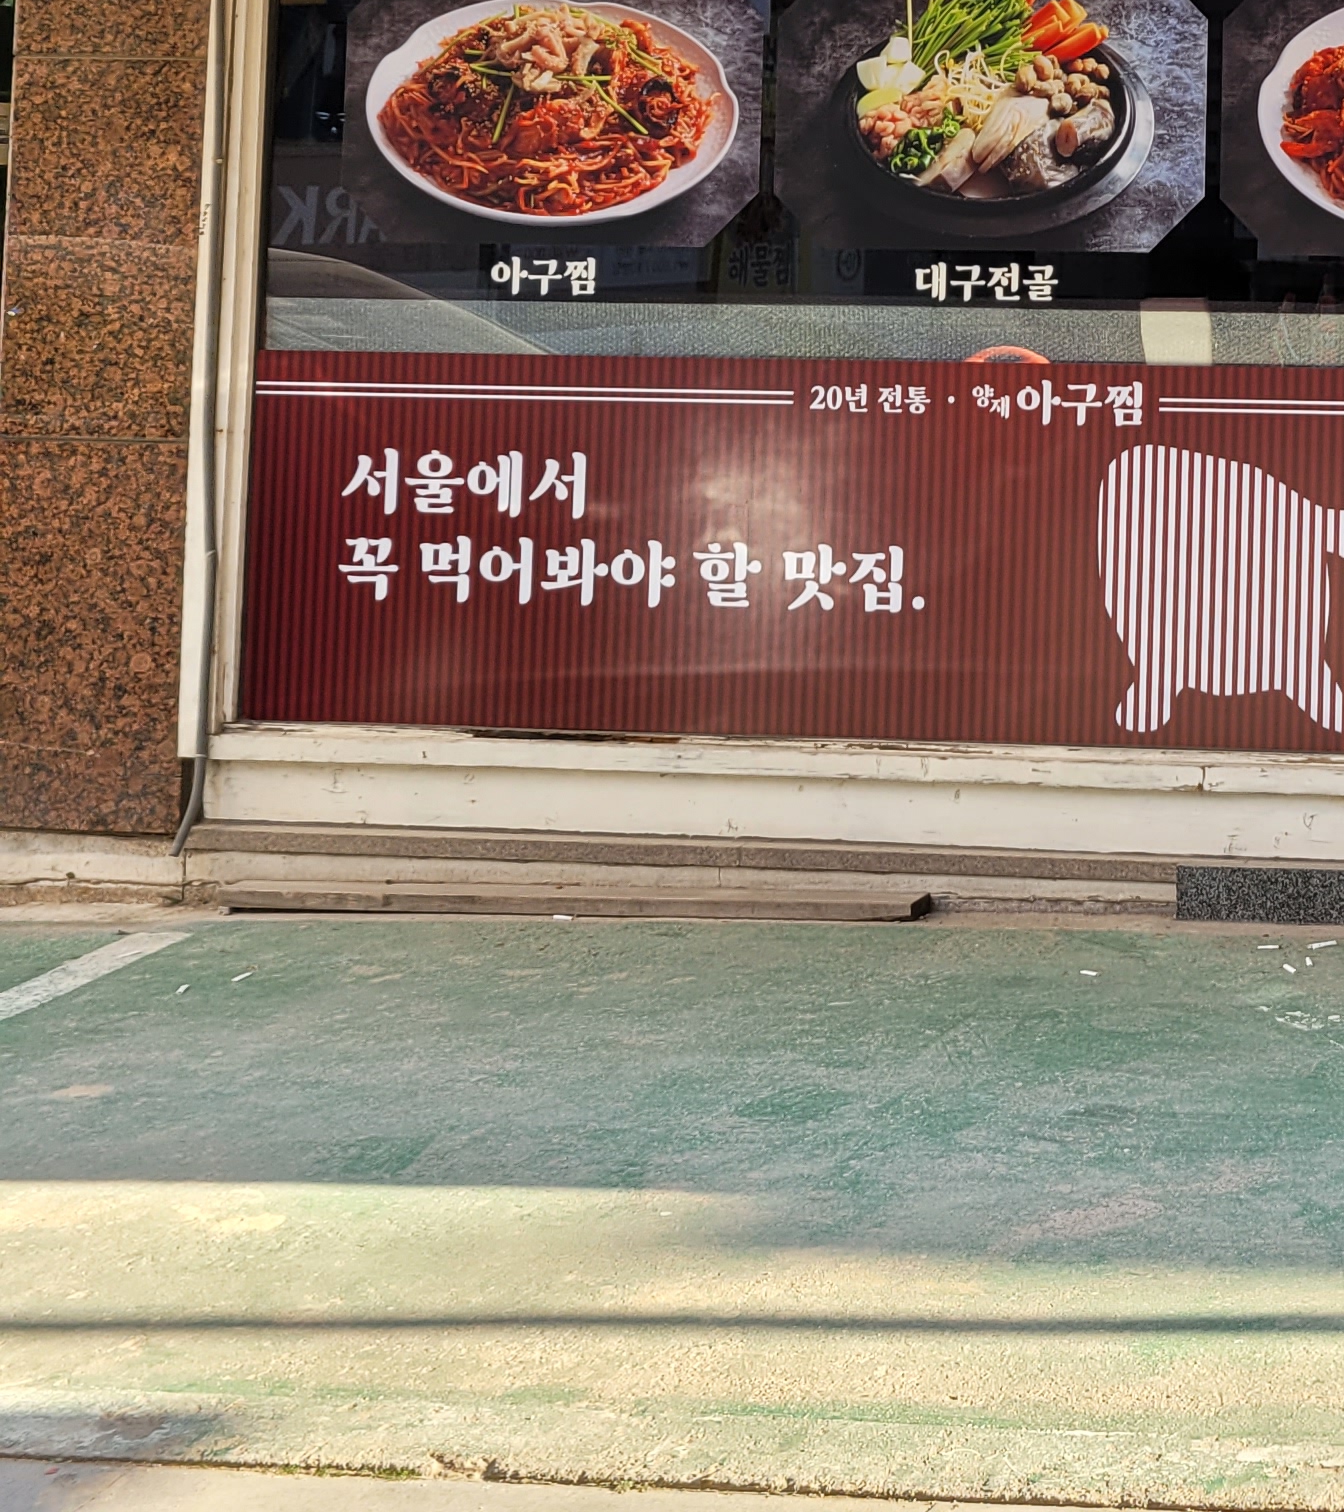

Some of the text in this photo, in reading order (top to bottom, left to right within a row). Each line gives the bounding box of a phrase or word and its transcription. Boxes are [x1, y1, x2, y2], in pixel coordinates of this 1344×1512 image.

[490, 255, 596, 296] 아구찜
[914, 261, 1059, 302] 대구전골
[809, 379, 1143, 427] 20년 전통 양재 아구찜
[341, 447, 587, 520] 서울에서
[338, 535, 925, 614] 꼭 먹어봐야 할 맛집.
